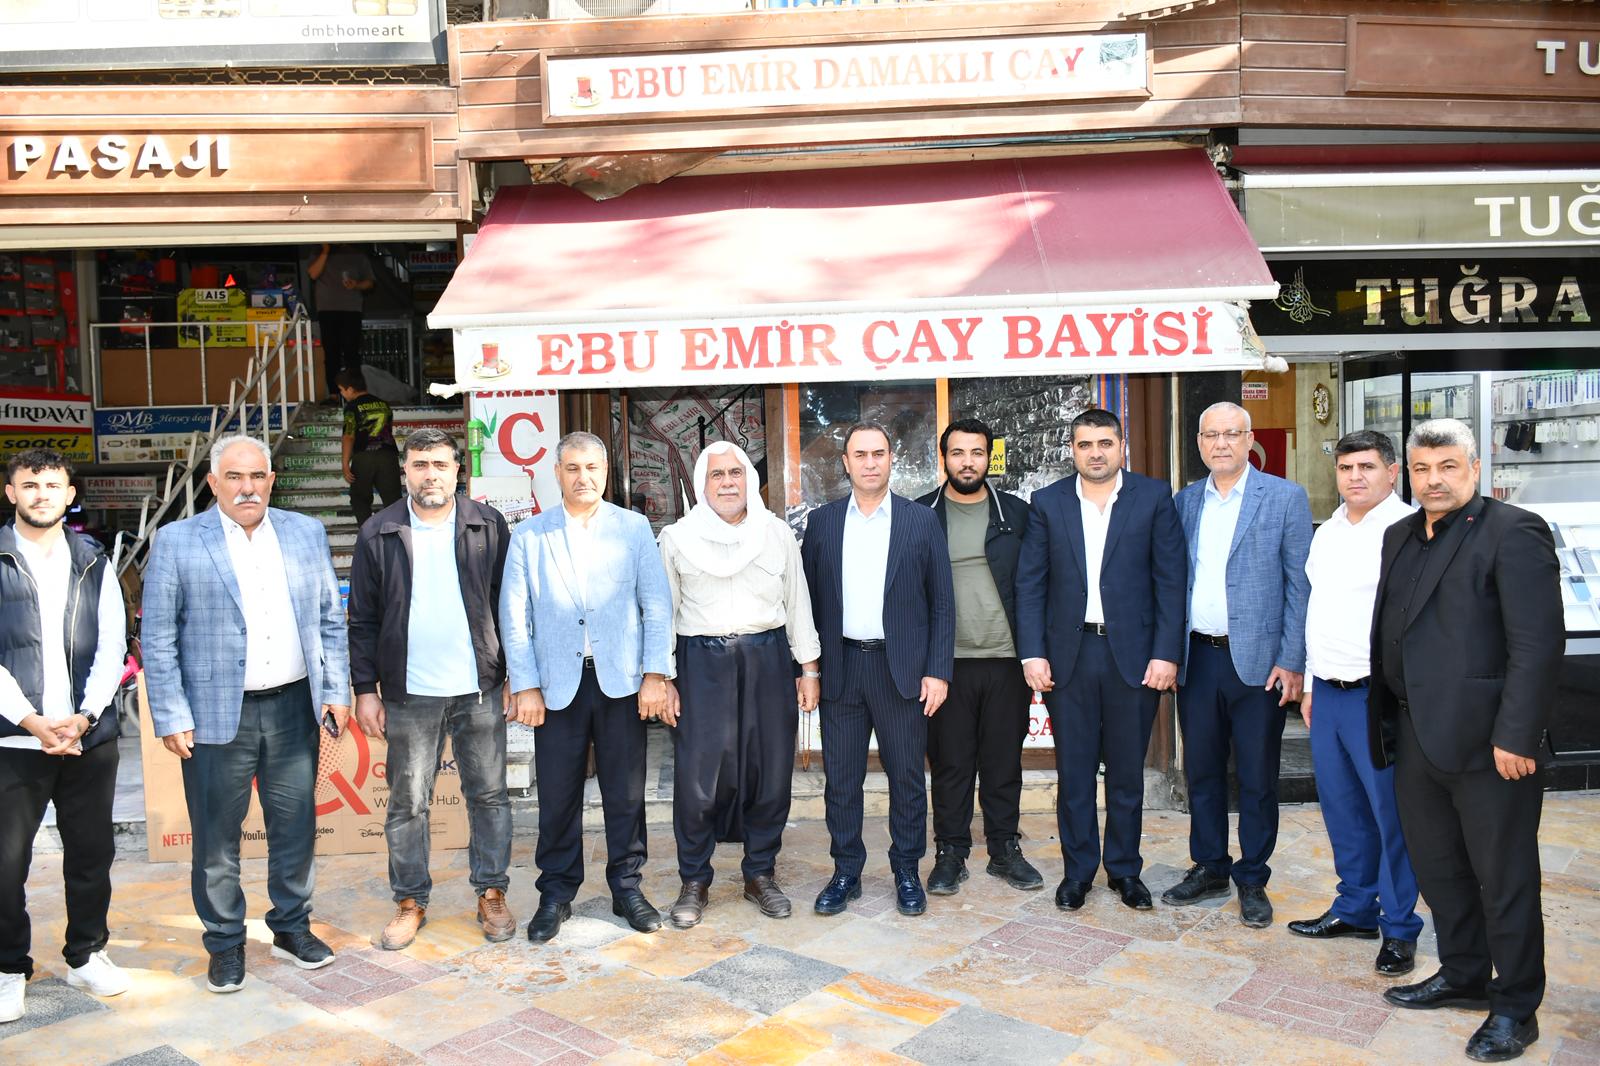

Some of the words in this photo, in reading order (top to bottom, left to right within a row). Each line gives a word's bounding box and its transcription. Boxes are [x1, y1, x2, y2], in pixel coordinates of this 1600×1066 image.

[301, 24, 404, 37] dmbhomeart
[609, 66, 686, 99] EBU
[700, 54, 801, 95] EMİR
[813, 51, 994, 90] DAMAKLI
[14, 136, 230, 172] PASAJI
[1355, 264, 1591, 326] TUĞRA
[537, 330, 658, 376] EBU
[680, 320, 842, 371] EMİR
[862, 317, 983, 370] ÇAY
[1003, 306, 1213, 360] BAYİSİ
[0, 404, 87, 423] HIRDAVAT
[366, 413, 384, 436] 7
[3, 436, 79, 449] saatçi
[1028, 717, 1053, 742] ÇA
[437, 795, 460, 806] Hub
[162, 833, 192, 847] NETF
[243, 830, 266, 841] YouTu
